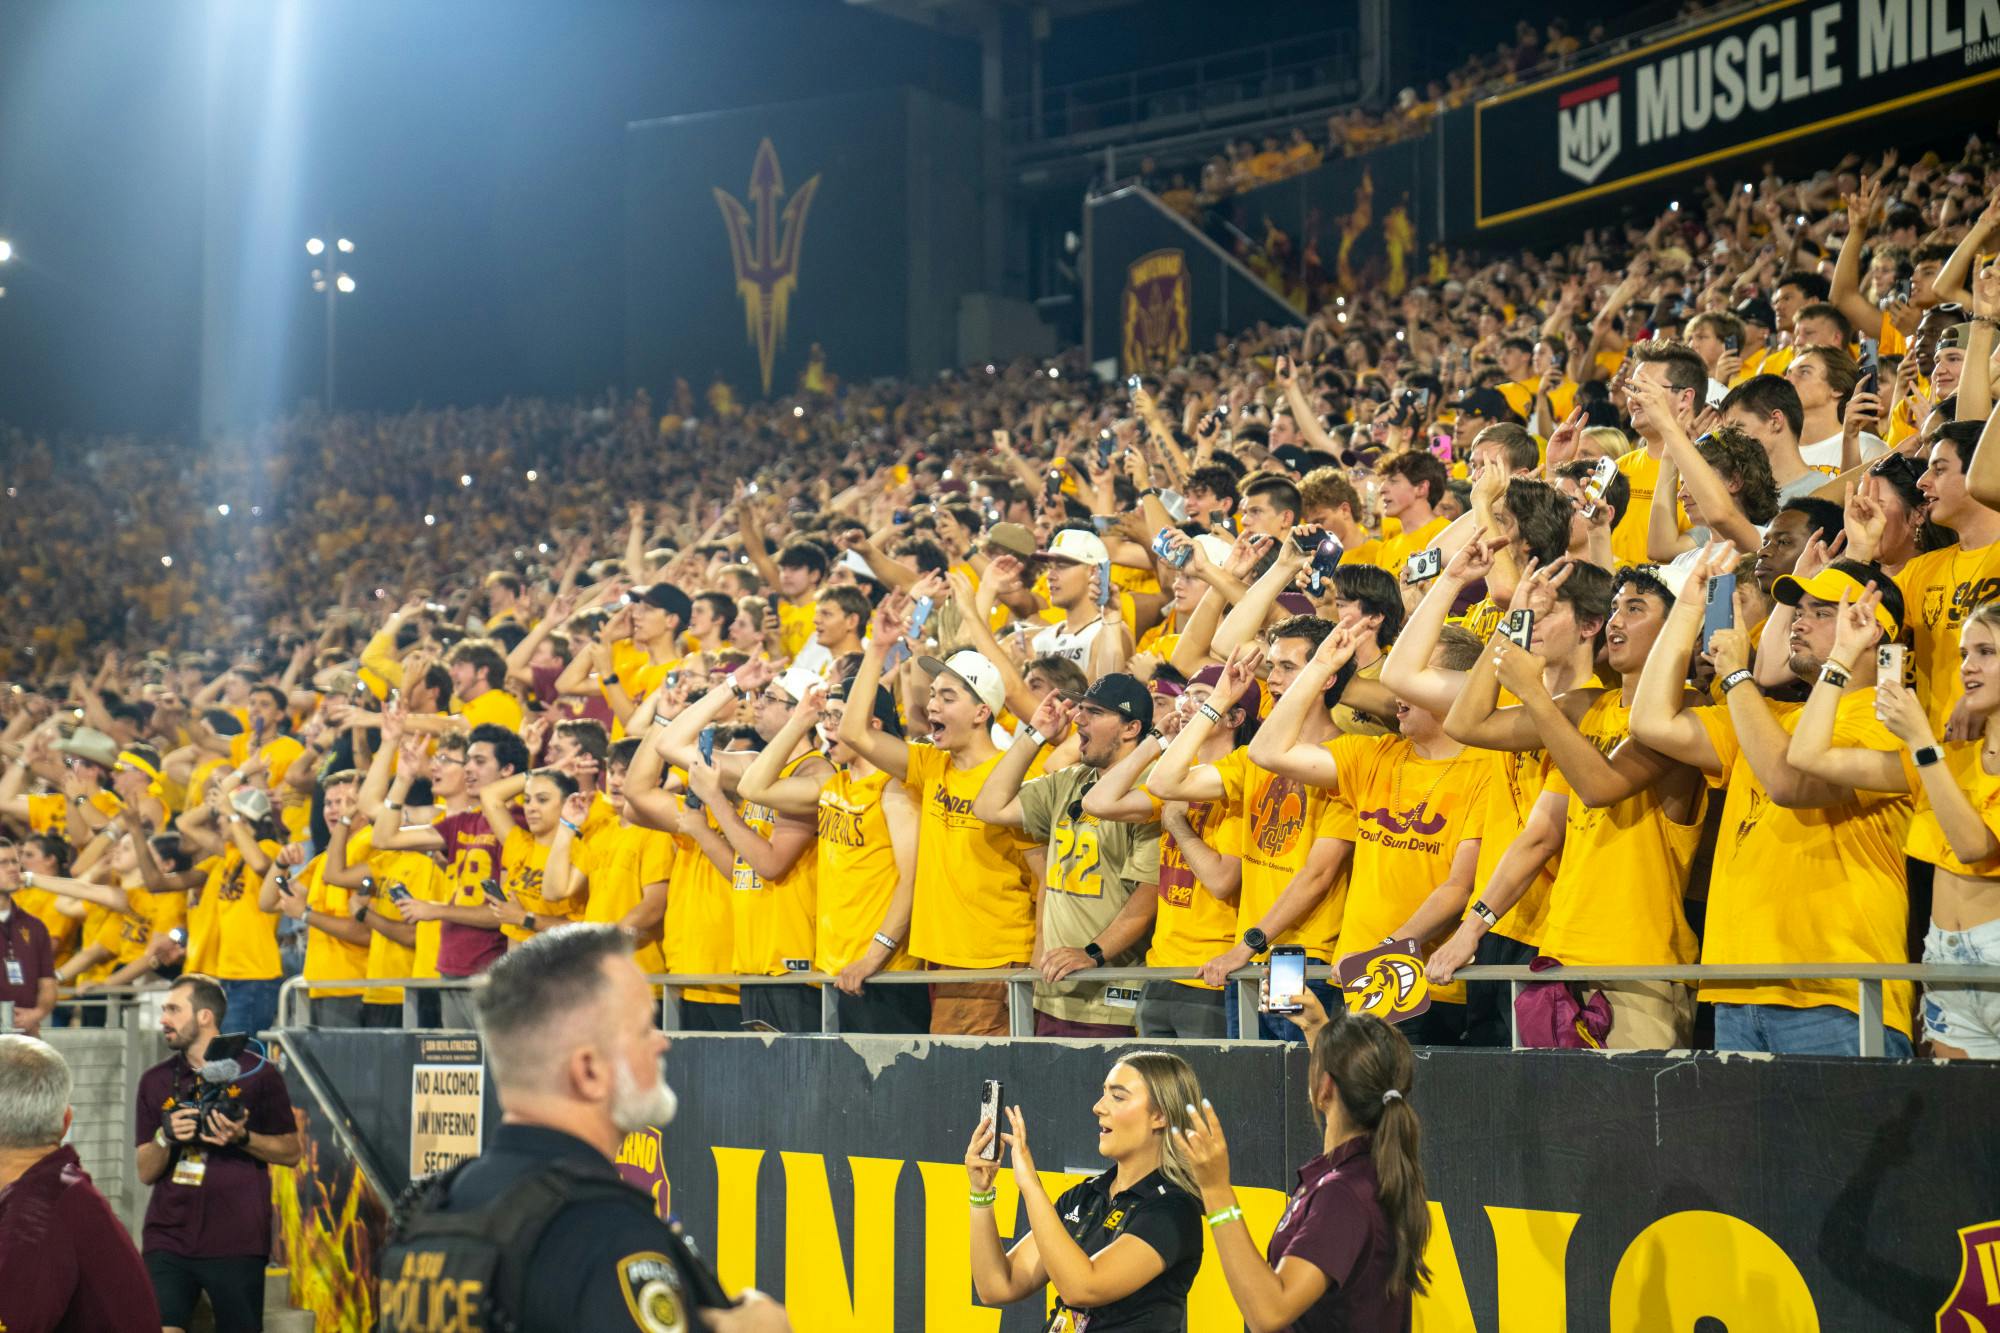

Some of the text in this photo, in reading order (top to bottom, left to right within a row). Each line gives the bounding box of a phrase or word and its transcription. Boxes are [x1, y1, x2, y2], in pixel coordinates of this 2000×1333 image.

[1964, 38, 2000, 66] BRAN
[1635, 2, 1843, 147] MUSCLE
[1381, 834, 1408, 850] Sun
[1407, 838, 1441, 855] Devil
[733, 870, 762, 889] TATE
[415, 1071, 480, 1096] NO ALCOHOL
[417, 1111, 476, 1136] IN INFERNO
[379, 1279, 483, 1333] POLICE
